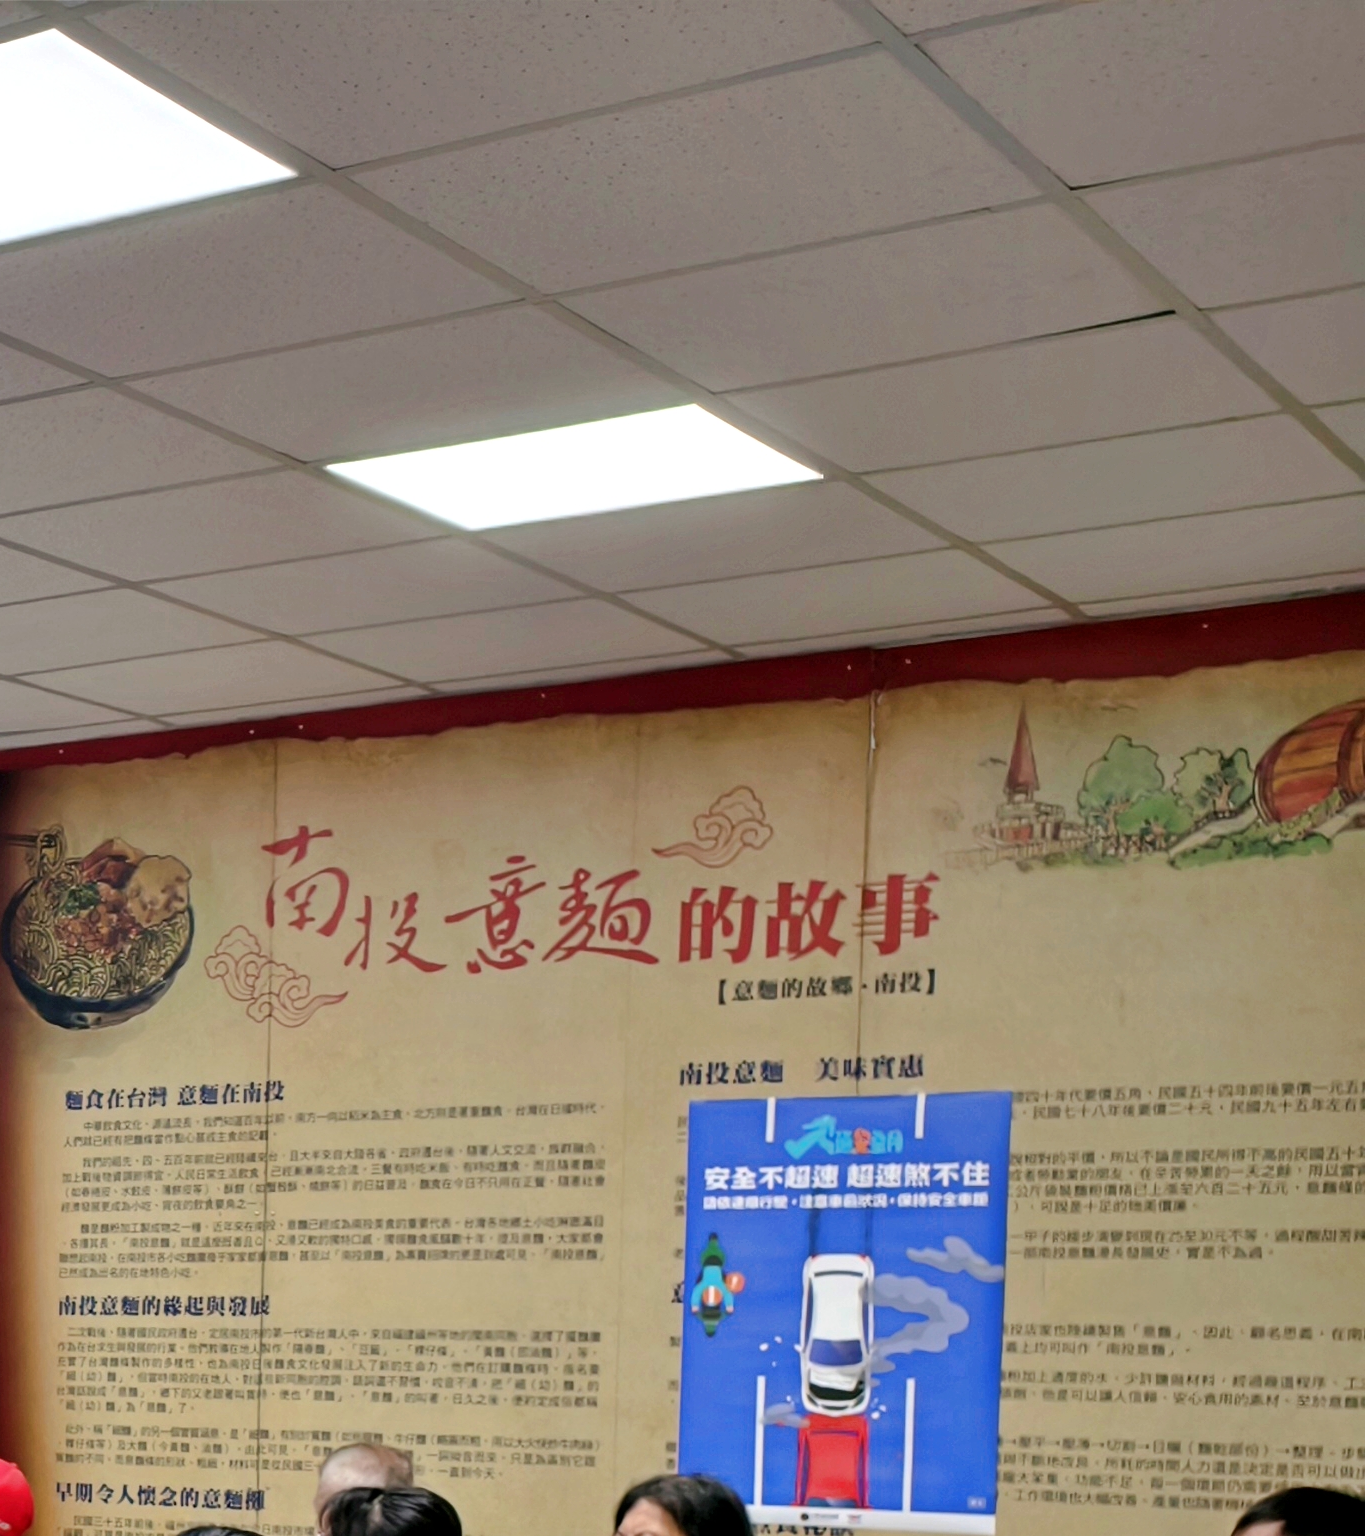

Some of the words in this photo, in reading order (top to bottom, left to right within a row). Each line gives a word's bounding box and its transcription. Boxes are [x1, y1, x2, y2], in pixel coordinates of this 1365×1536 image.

[259, 825, 942, 974] 南投意麵的故事
[678, 1059, 784, 1086] 南投意麵
[816, 1053, 924, 1082] 美味實惠
[64, 1086, 167, 1111] 麵食在台灣
[176, 1080, 286, 1107] 意麵在南投
[704, 1164, 839, 1190] 安全不超速
[846, 1161, 990, 1188] 超速煞不住
